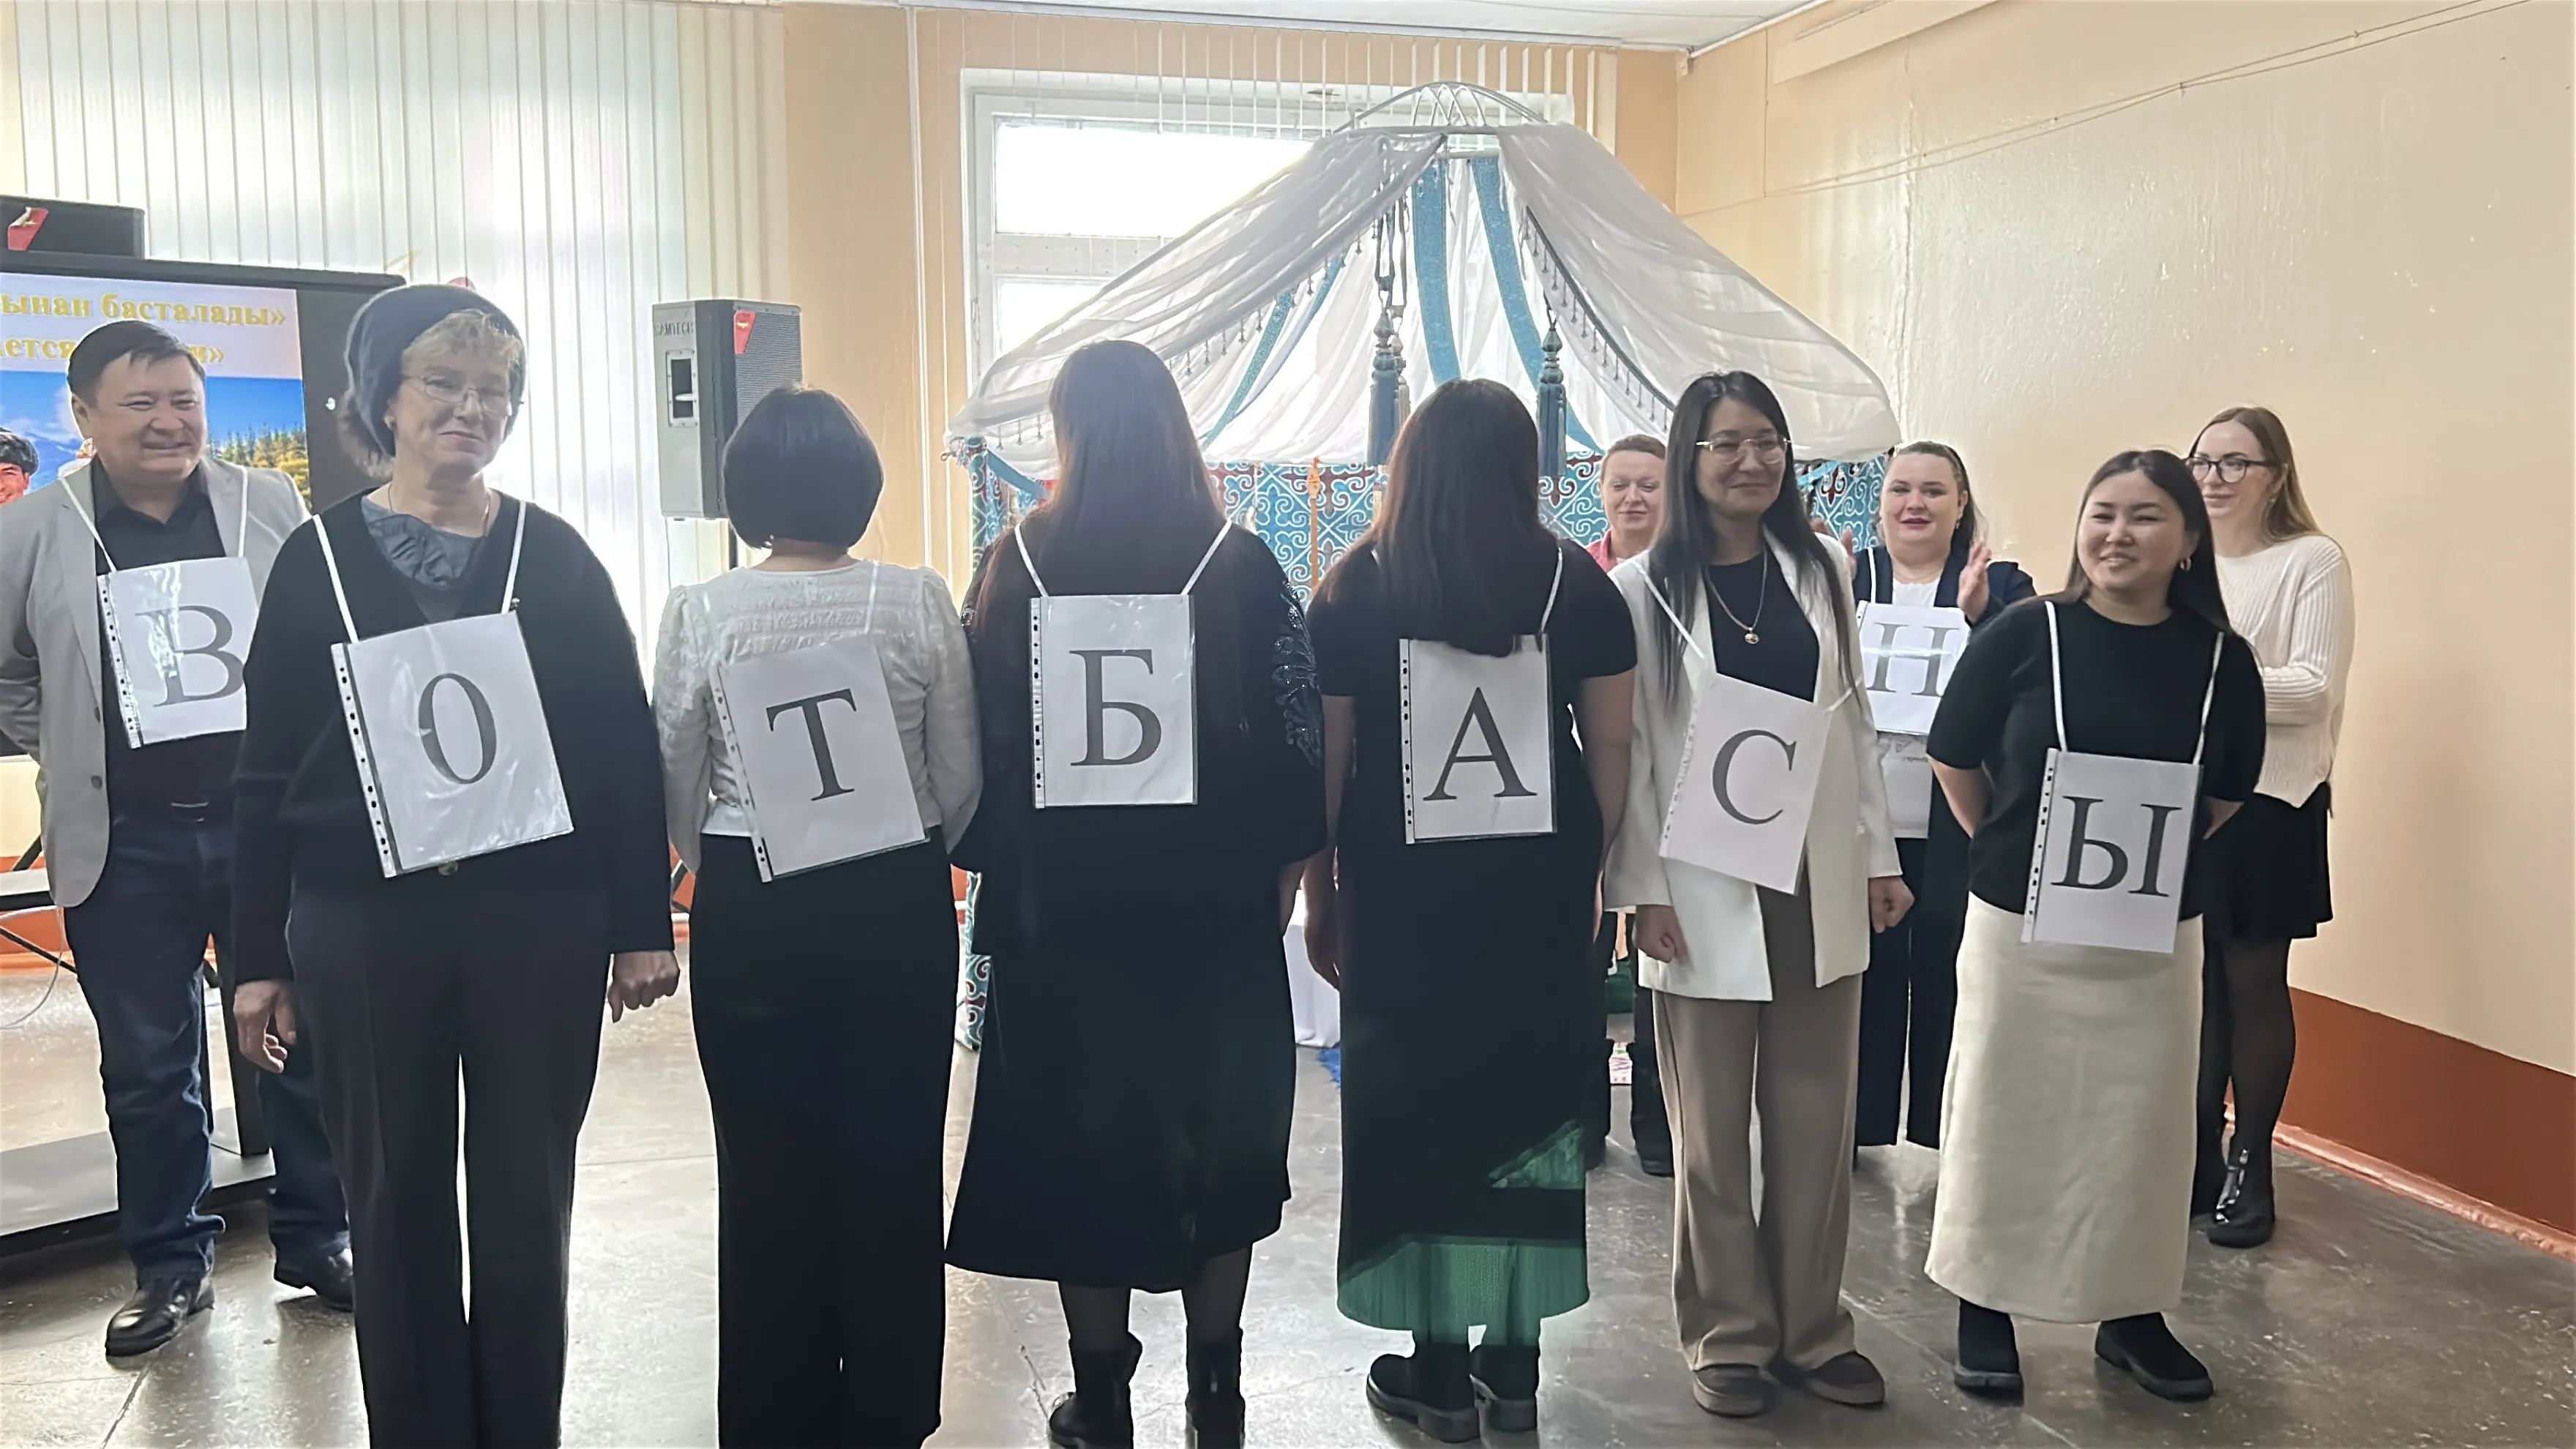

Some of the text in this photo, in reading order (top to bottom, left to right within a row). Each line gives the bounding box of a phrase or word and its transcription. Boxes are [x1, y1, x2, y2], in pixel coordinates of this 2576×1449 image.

[0, 337, 75, 359] ется
[101, 292, 285, 326] басталады»
[135, 604, 244, 708] В
[1068, 649, 1162, 766] Б
[1867, 622, 1960, 697] Н
[417, 673, 497, 785] О
[765, 688, 857, 801] Т
[1423, 686, 1538, 801] А
[1712, 729, 1797, 825] С
[2051, 795, 2182, 898] Ы
